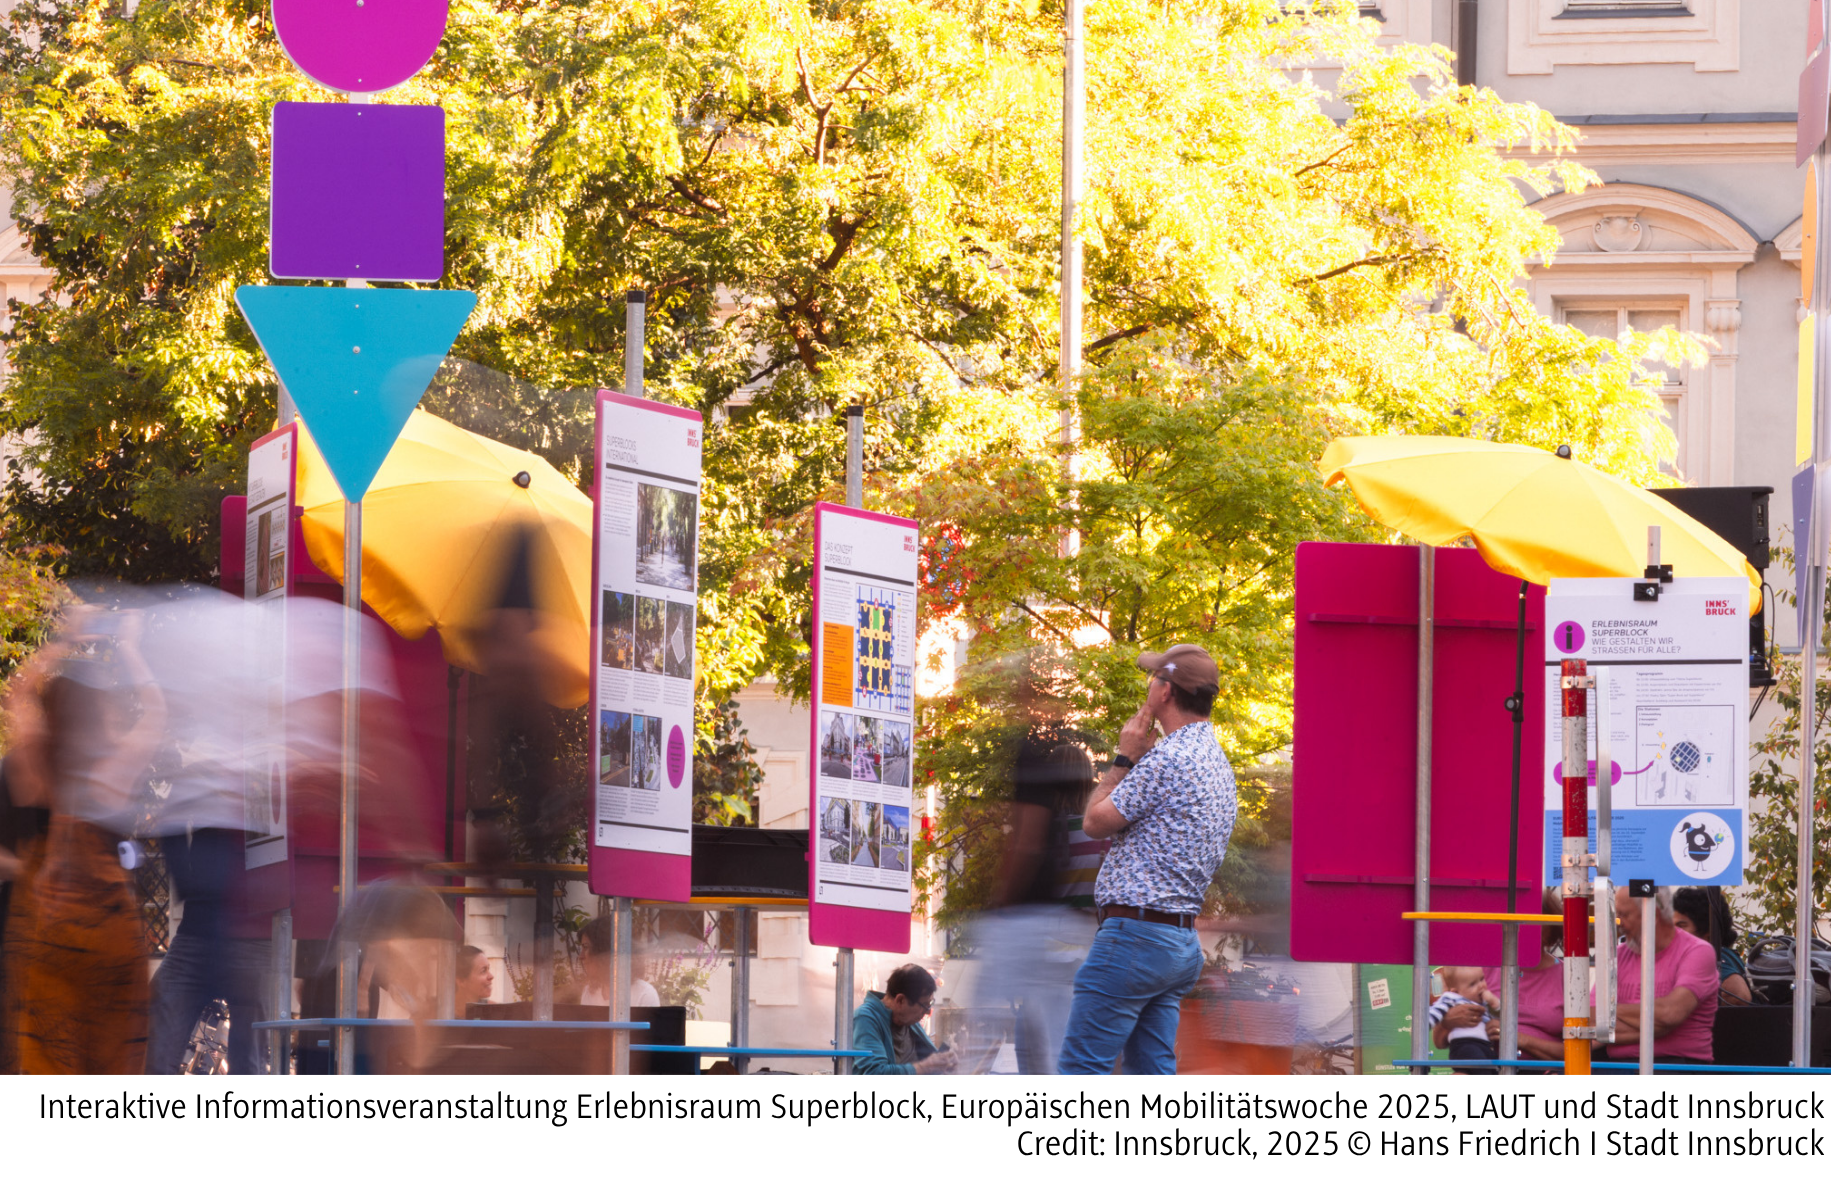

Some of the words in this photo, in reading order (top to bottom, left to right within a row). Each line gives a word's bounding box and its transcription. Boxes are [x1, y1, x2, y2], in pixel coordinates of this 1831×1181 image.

[606, 435, 637, 452] SUPERBLOCKS
[606, 448, 639, 465] INTERNATIONAL
[824, 541, 834, 552] DAS
[834, 542, 853, 555] KONZEPT
[824, 553, 852, 566] SUPERBLOCK
[1705, 607, 1736, 616] BRUCK
[1592, 620, 1658, 628] ERLEBNISRAUM
[1591, 629, 1648, 637] SUPERBLOCK
[1591, 638, 1607, 646] WIE
[1609, 637, 1657, 646] GESTALTEN
[1658, 637, 1674, 645] WIR
[1591, 646, 1636, 654] STRASSEN
[1637, 644, 1655, 654] FÜR
[1656, 646, 1681, 654] ALLE?
